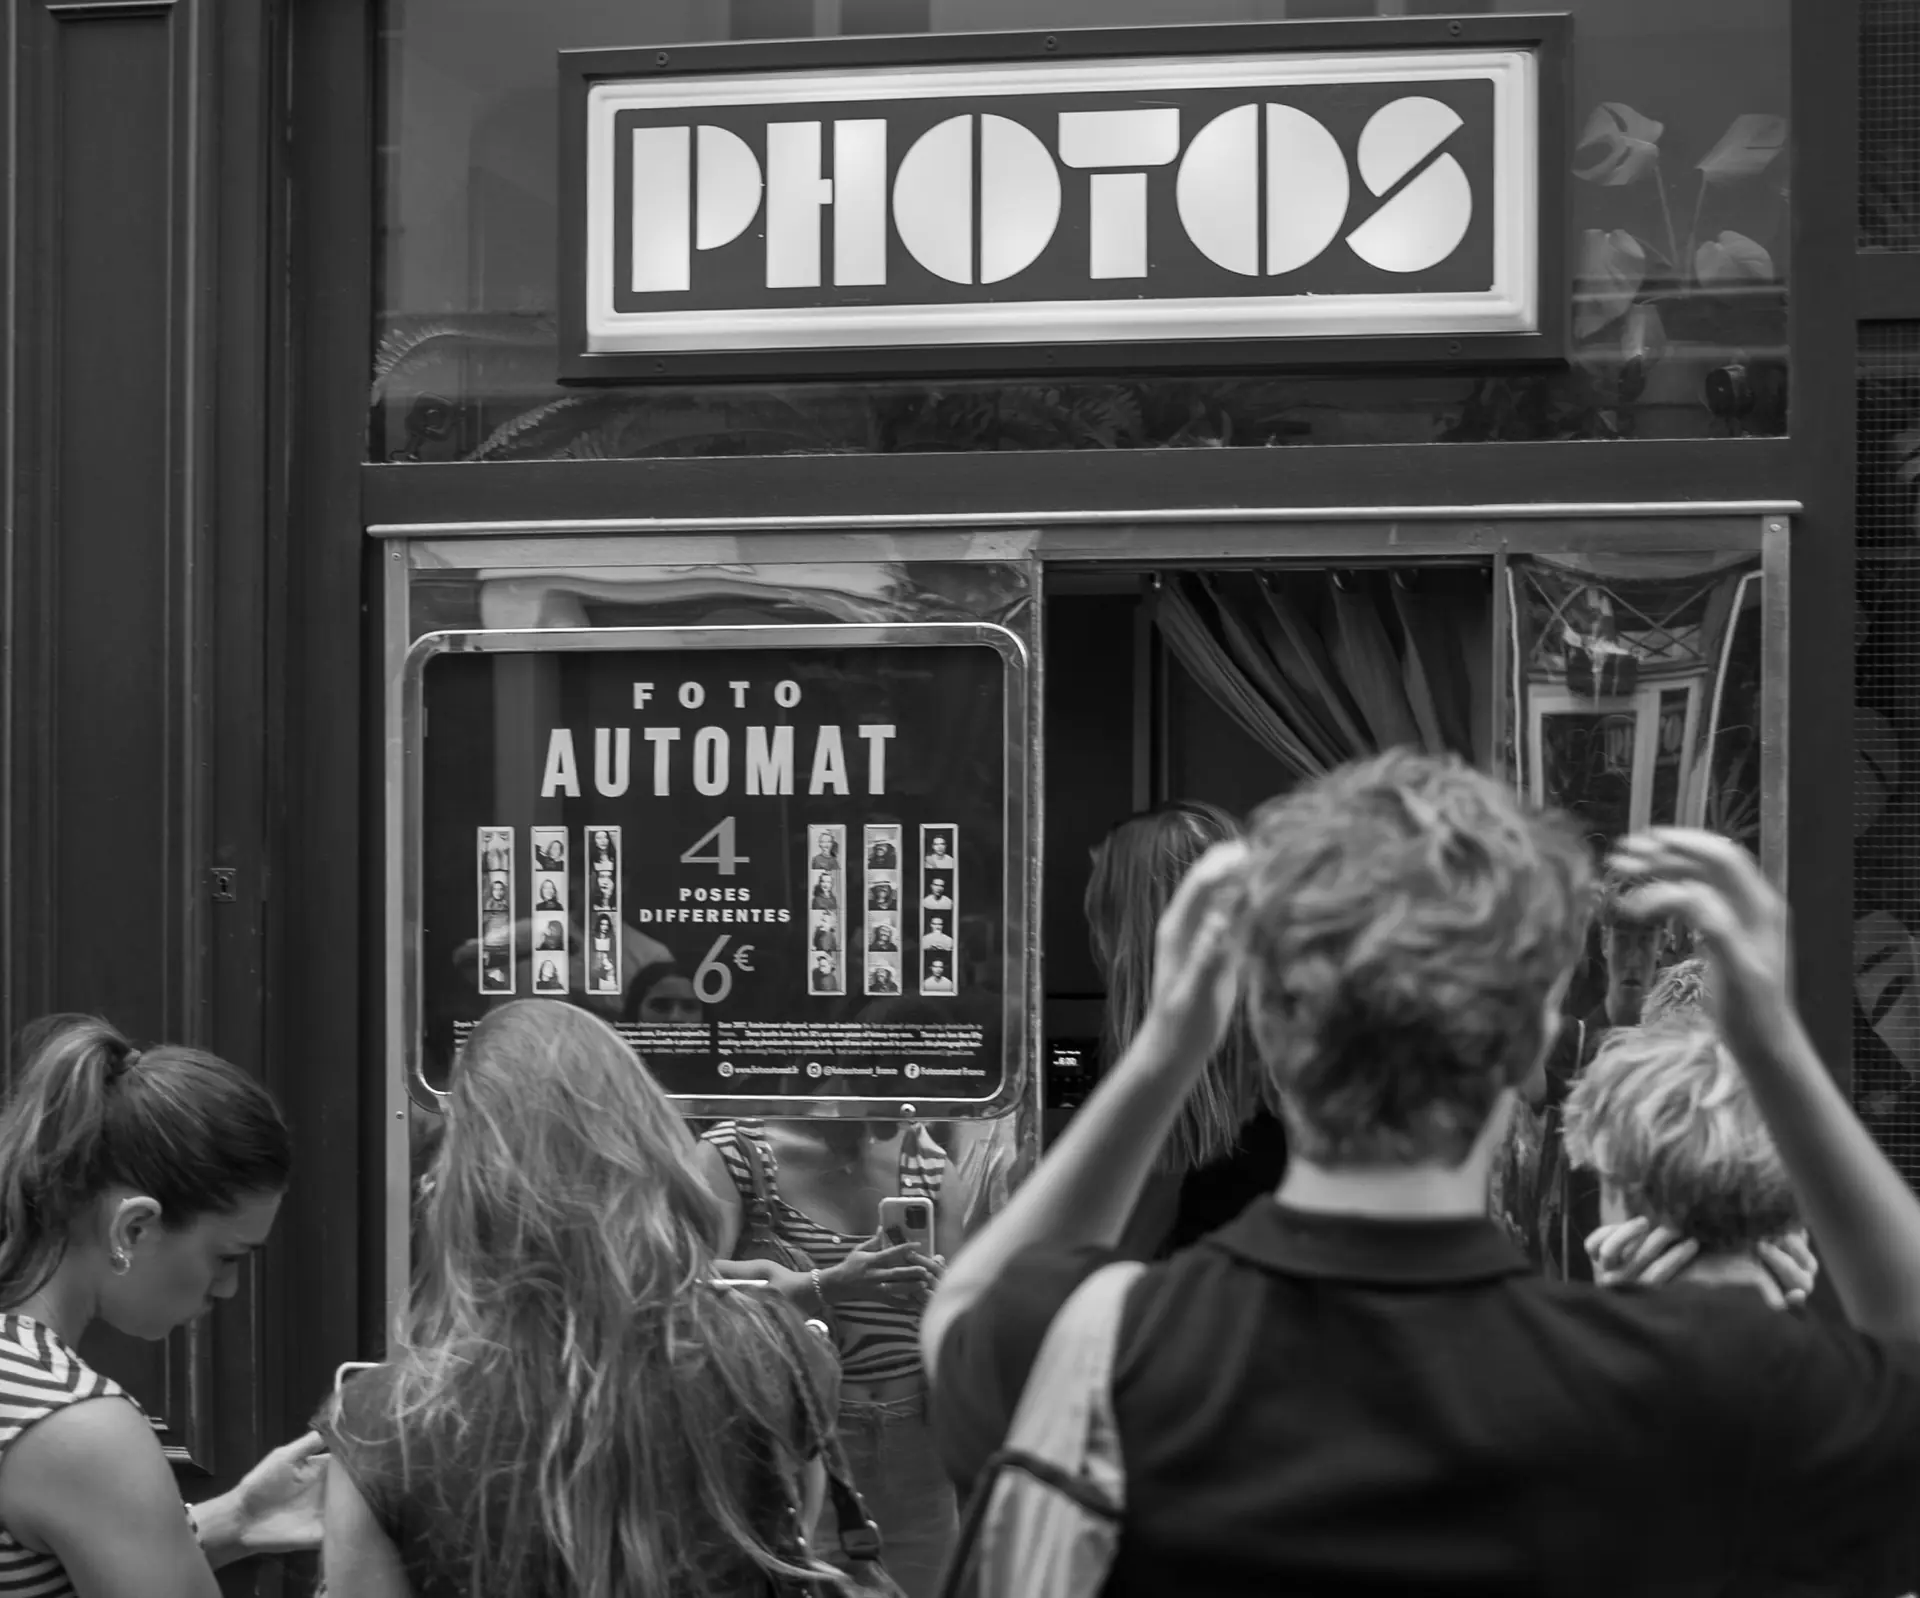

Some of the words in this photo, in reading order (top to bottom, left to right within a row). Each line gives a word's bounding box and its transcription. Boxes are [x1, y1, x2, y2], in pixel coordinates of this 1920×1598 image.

[631, 95, 1473, 293] PHOTOS
[633, 679, 802, 710] FOTO
[540, 724, 897, 798] AUTOMAT
[680, 816, 750, 875] 4
[639, 908, 792, 923] DIFFERENTES
[679, 887, 752, 902] POSES
[692, 934, 755, 1004] 6€
